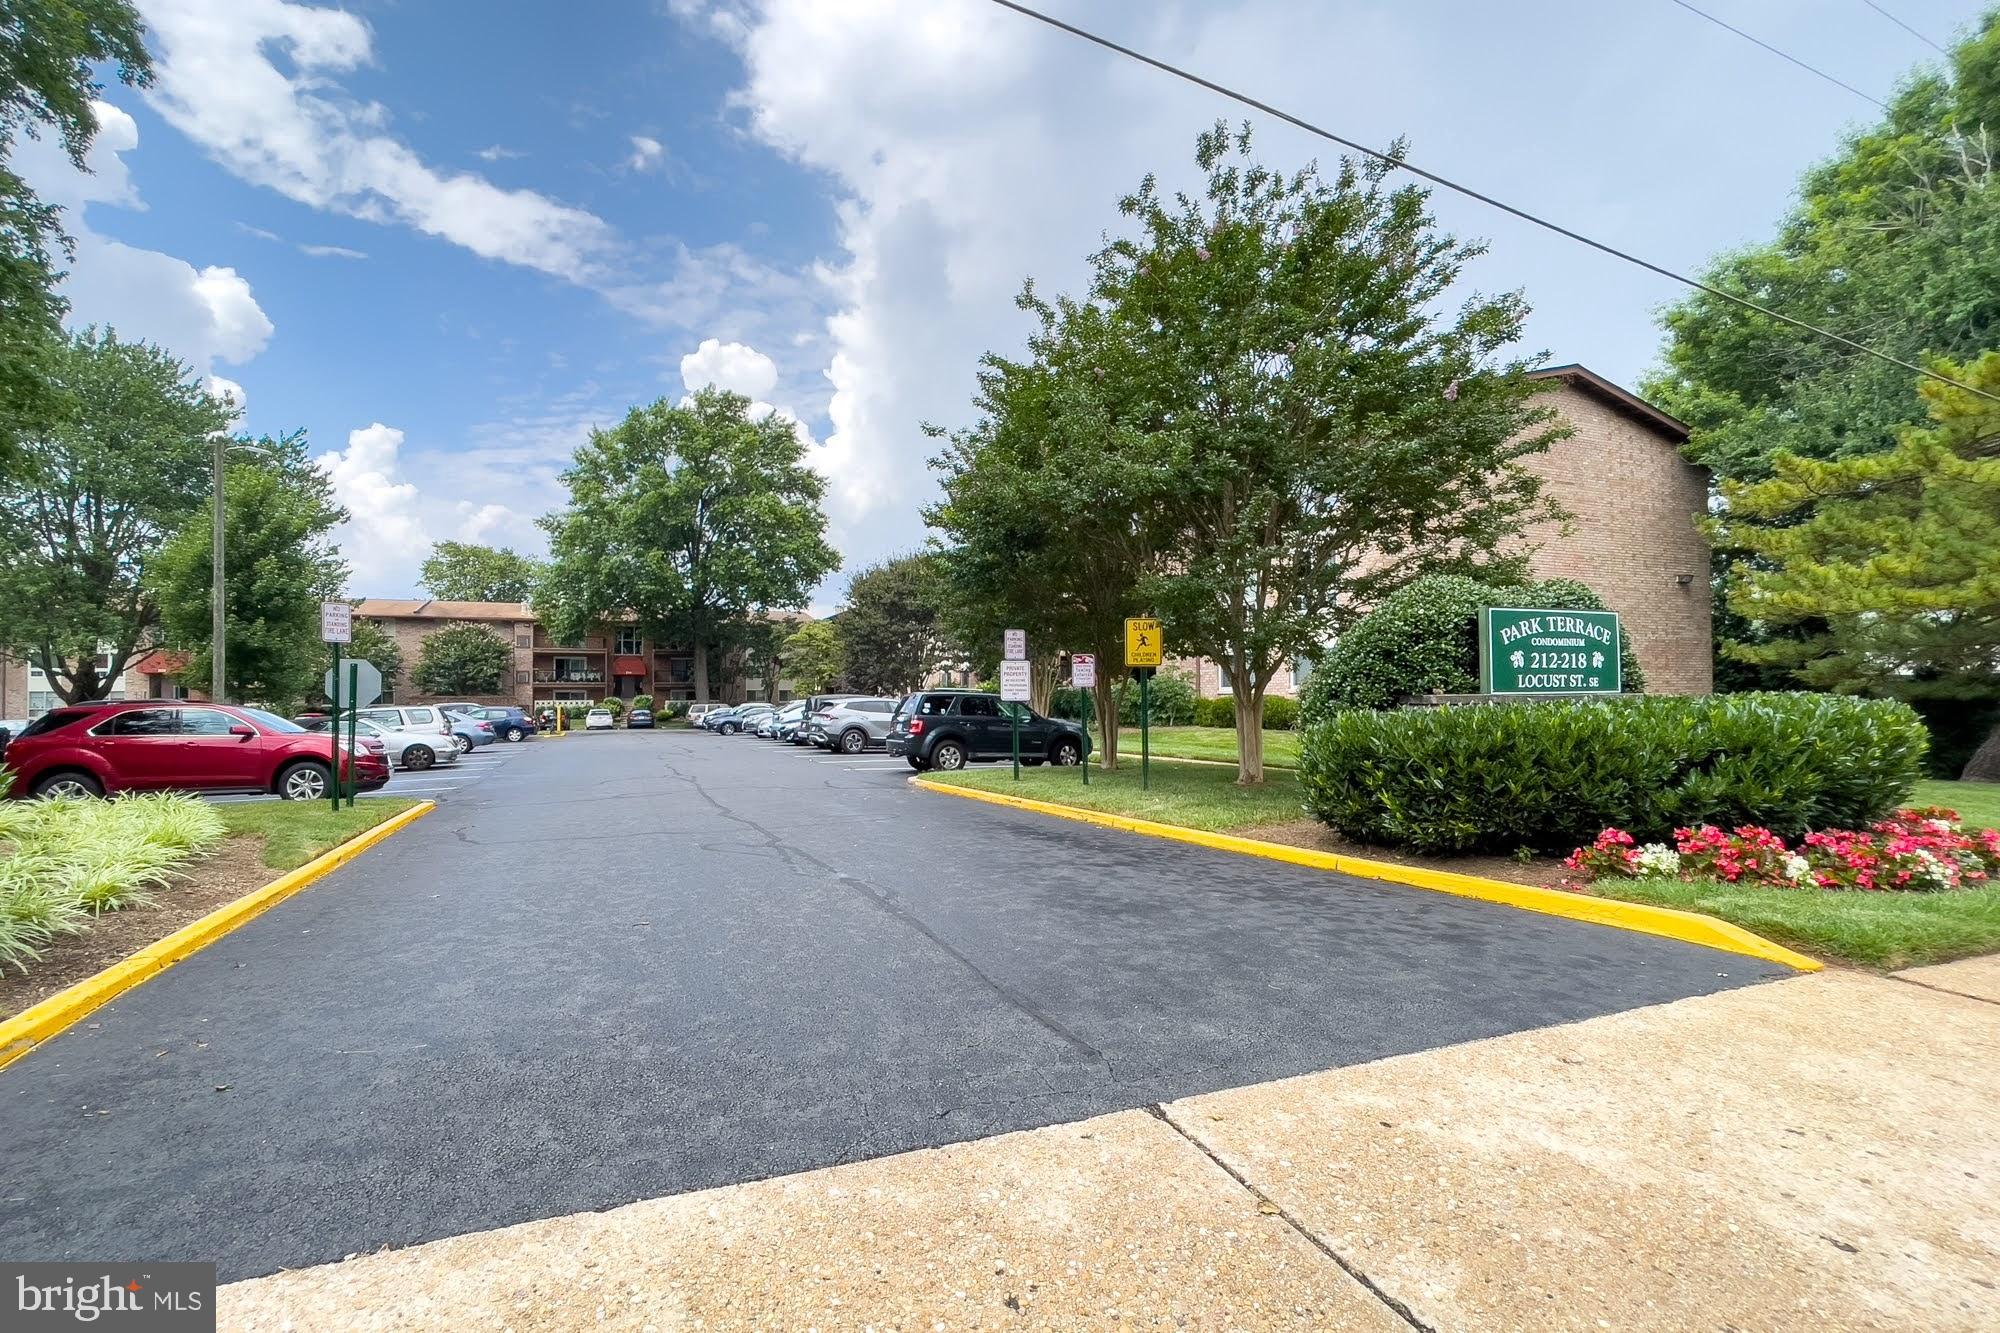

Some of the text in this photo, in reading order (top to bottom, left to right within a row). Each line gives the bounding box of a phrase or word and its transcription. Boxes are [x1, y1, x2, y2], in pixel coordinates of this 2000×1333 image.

[1132, 621, 1155, 631] SLOW
[1500, 616, 1612, 645] PARK TERRACE
[1531, 637, 1585, 647] CONDOMINIUM
[1530, 652, 1588, 669] 212-218
[1517, 674, 1600, 688] LOCUST ST. SE
